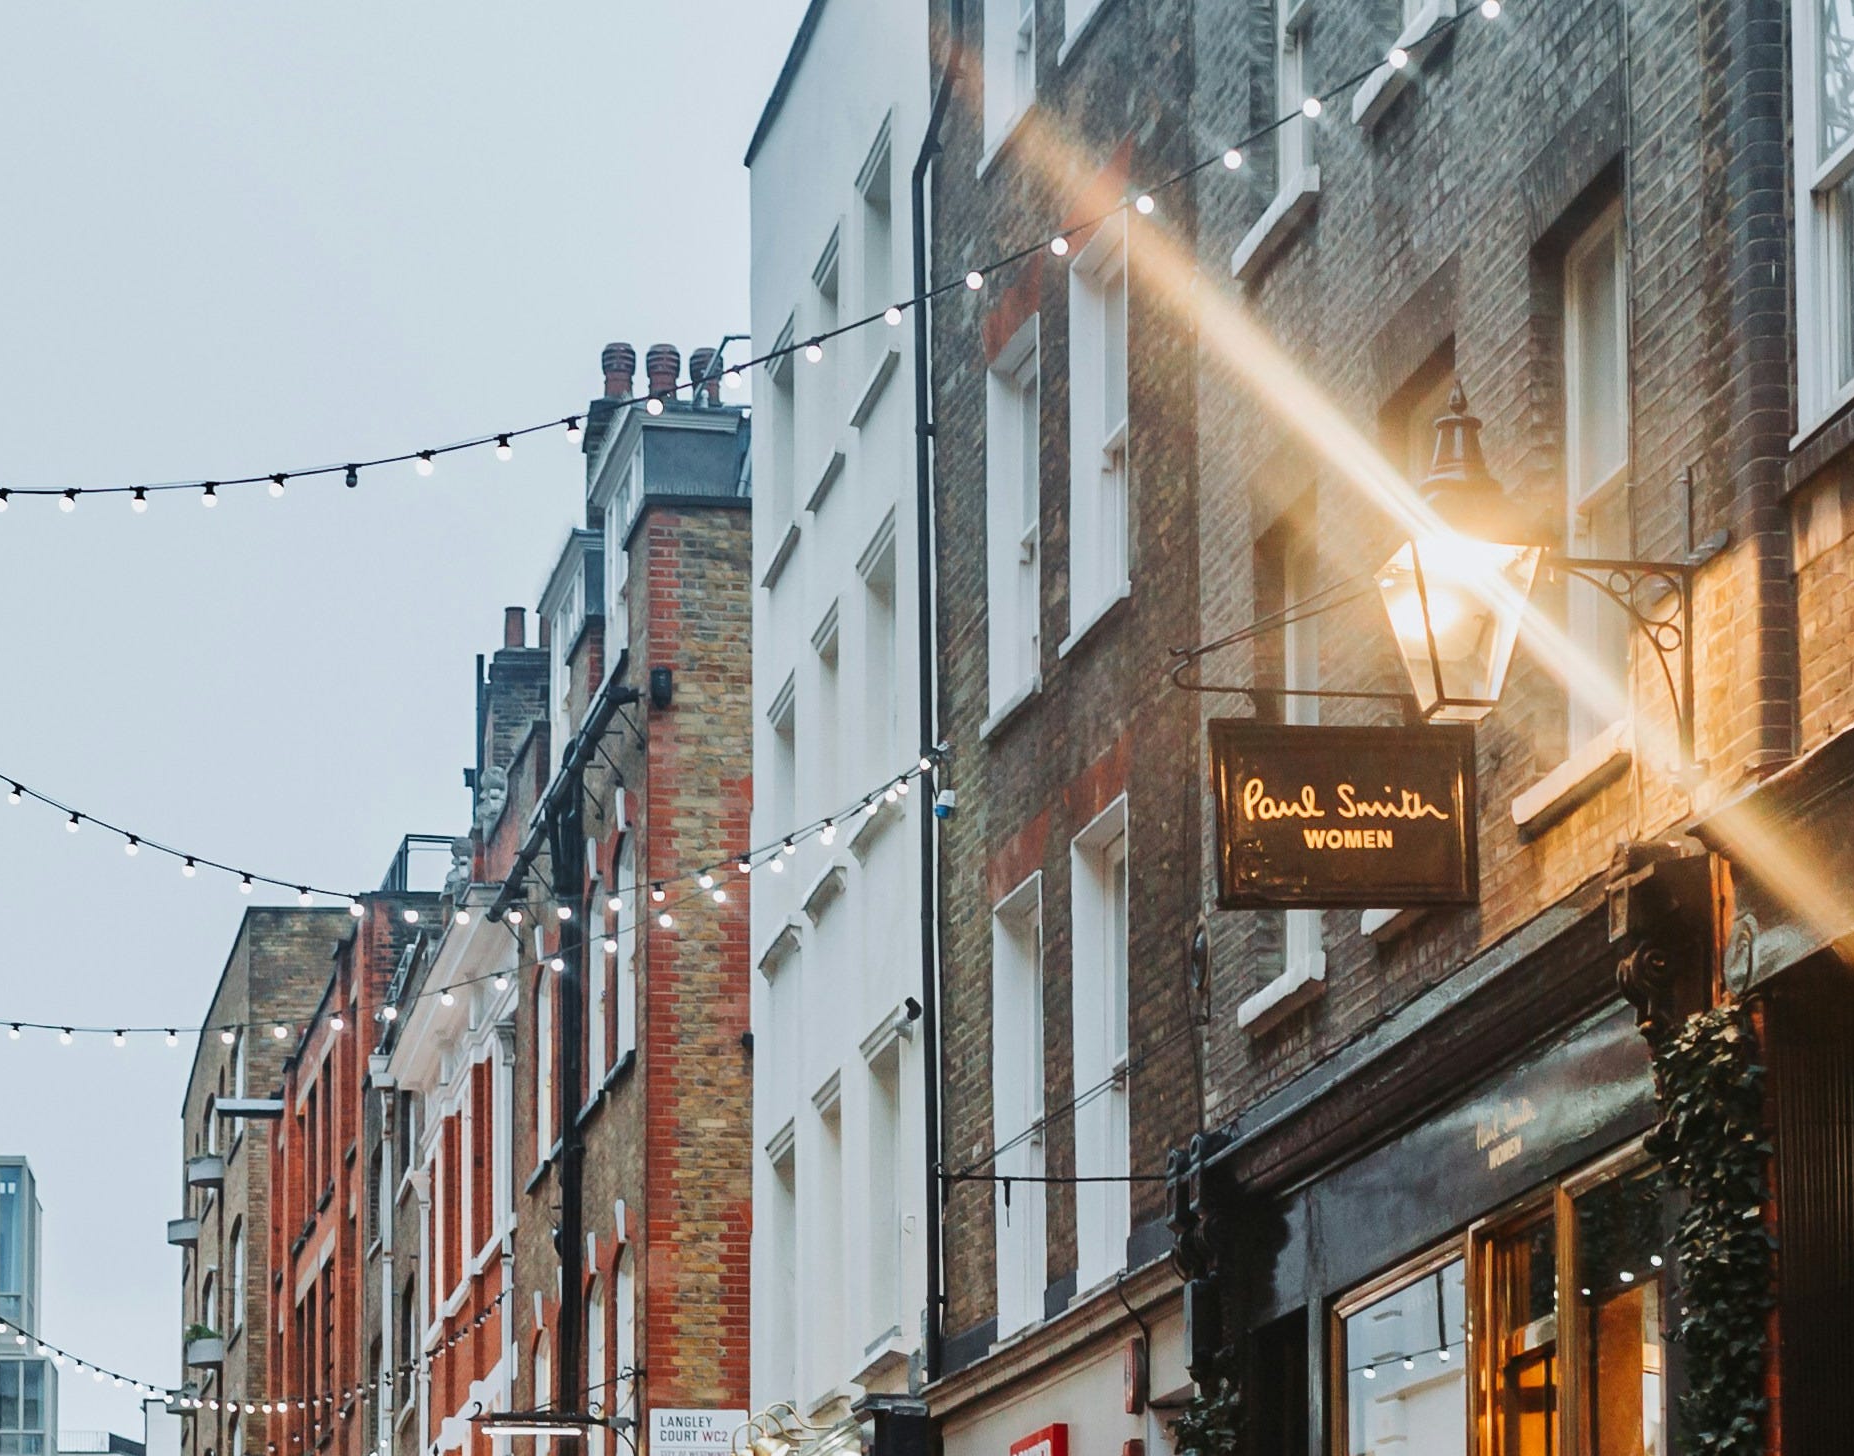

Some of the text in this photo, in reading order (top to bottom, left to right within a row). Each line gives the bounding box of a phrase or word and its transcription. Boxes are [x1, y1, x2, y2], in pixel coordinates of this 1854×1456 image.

[1243, 778, 1449, 821] Paul Smith
[1303, 829, 1393, 849] WOMEN
[660, 1415, 713, 1428] LANGLEY
[660, 1430, 728, 1442] COURT WC2
